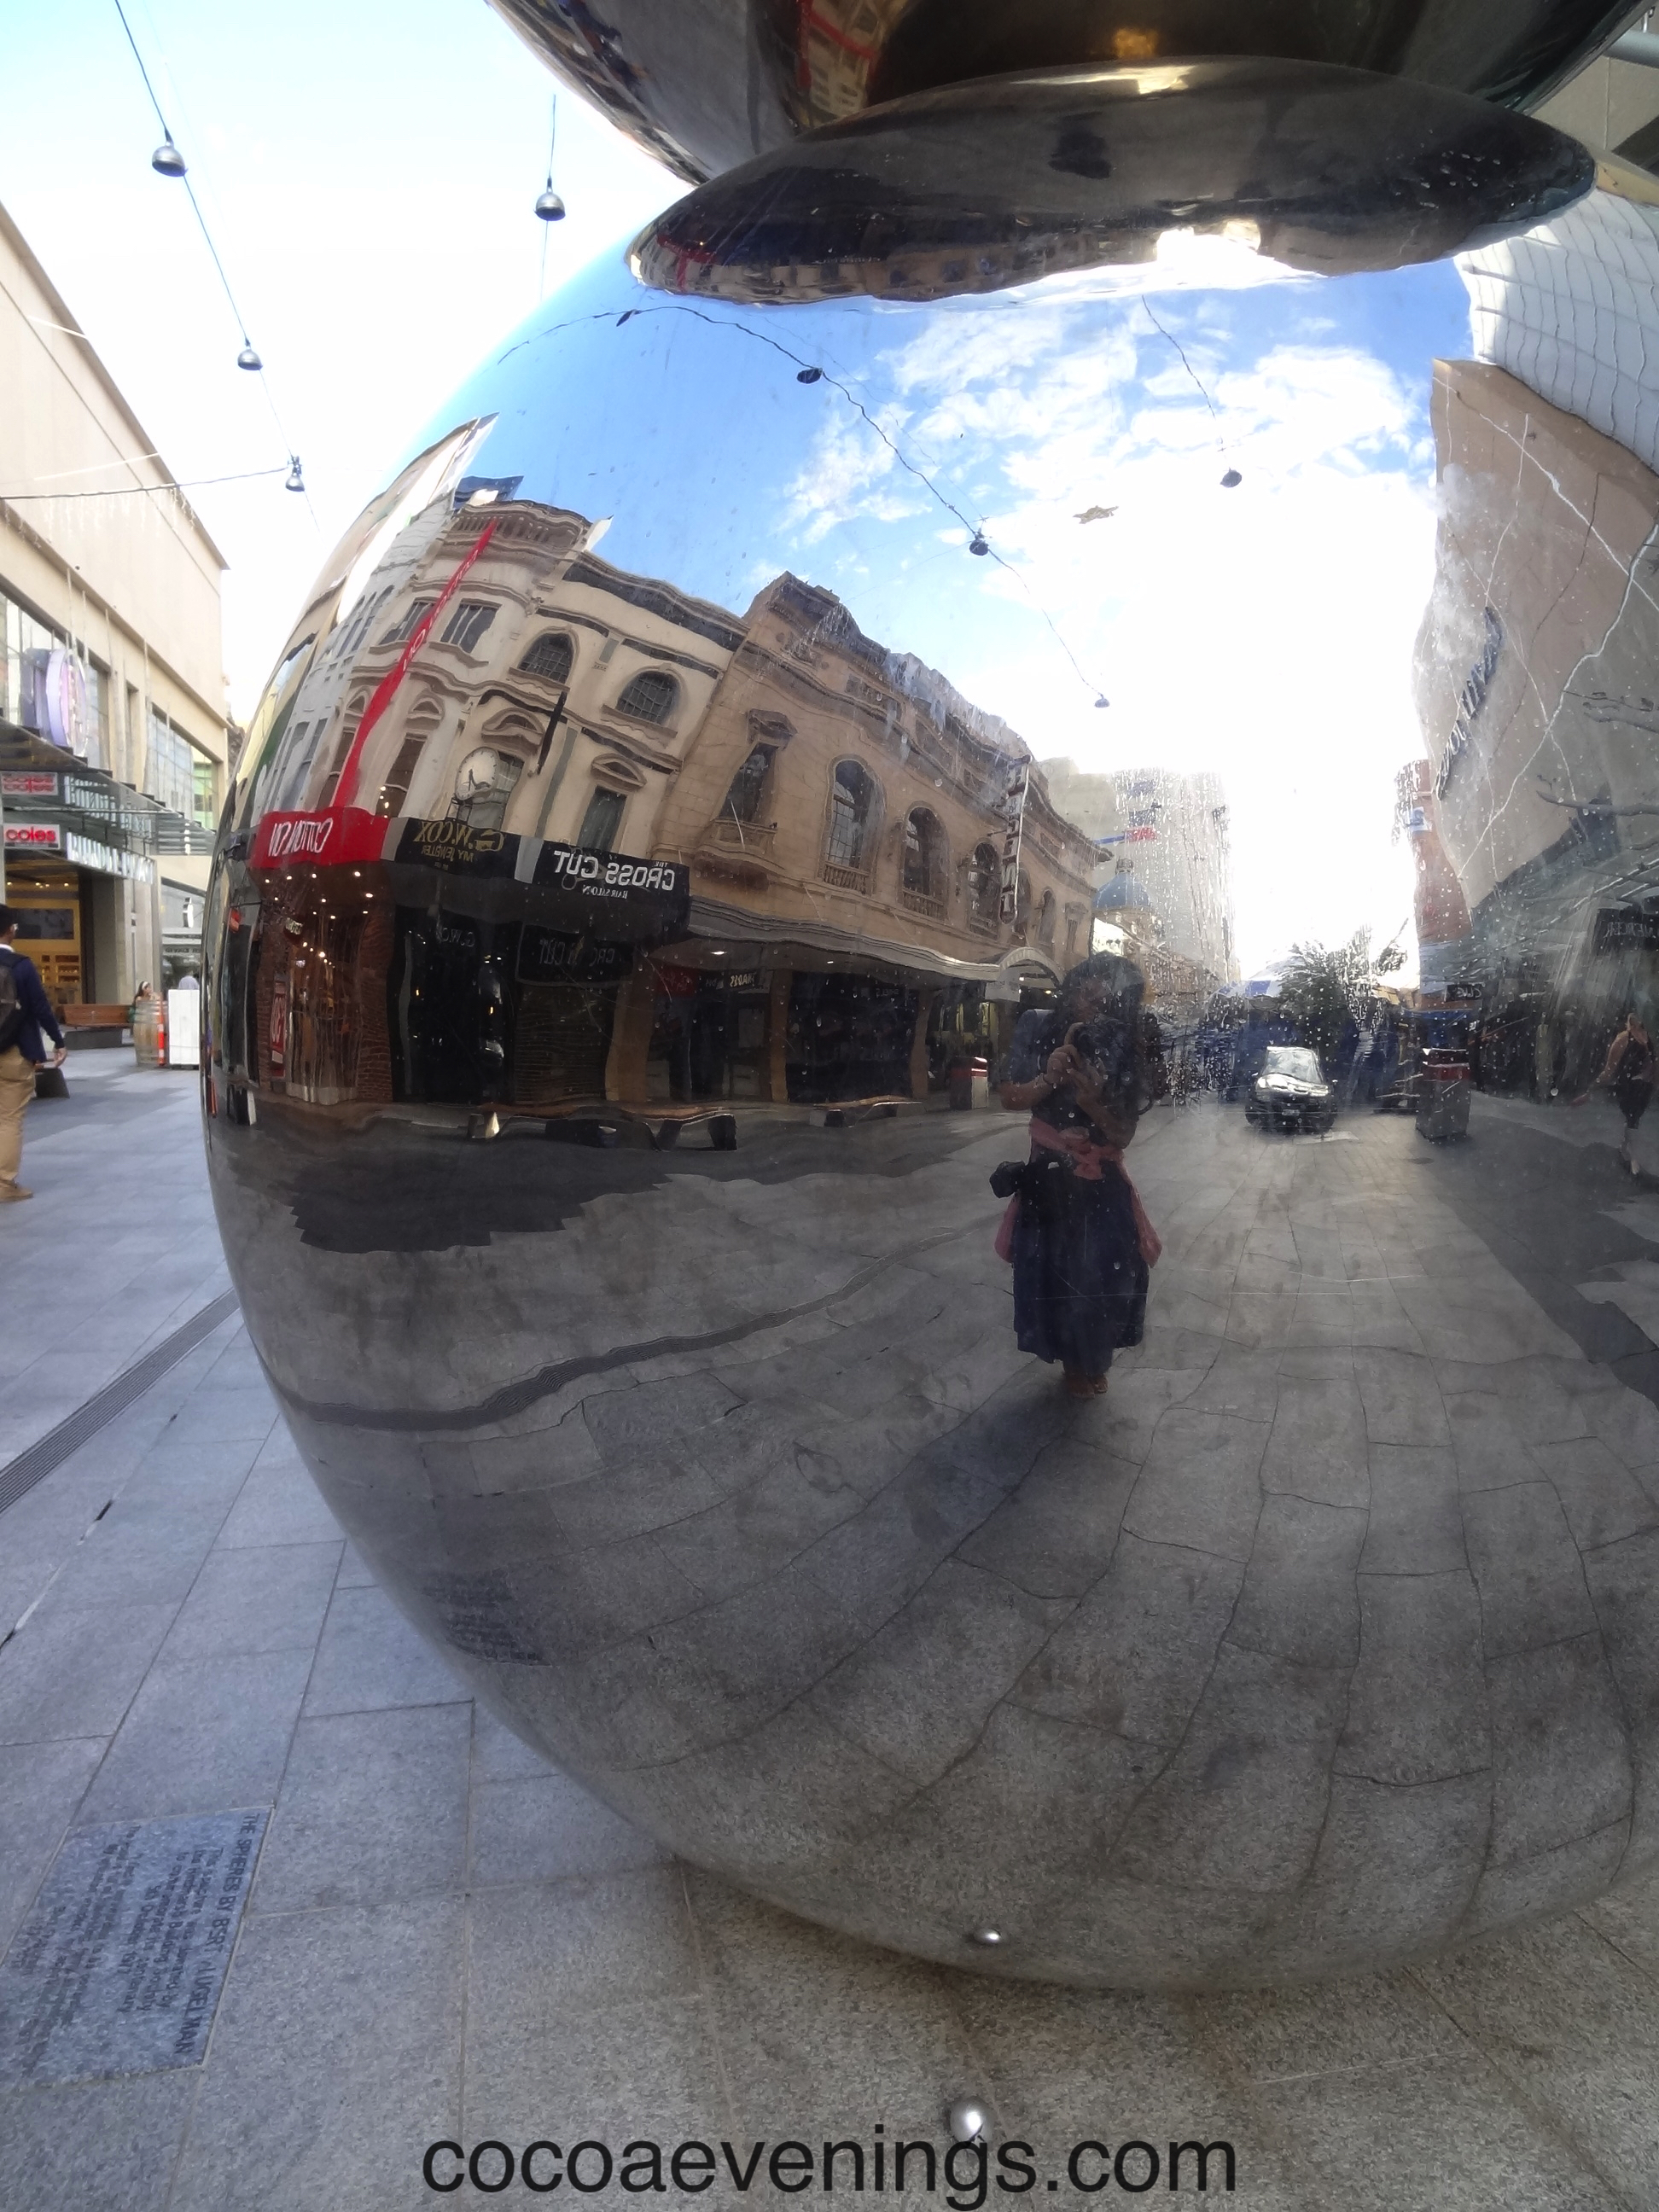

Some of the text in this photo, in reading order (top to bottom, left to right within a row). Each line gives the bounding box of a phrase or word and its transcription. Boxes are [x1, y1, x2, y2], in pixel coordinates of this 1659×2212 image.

[6, 826, 55, 841] coles
[238, 1813, 259, 1834] THE
[221, 1837, 253, 1892] SPHERES
[215, 1895, 236, 1912] BY
